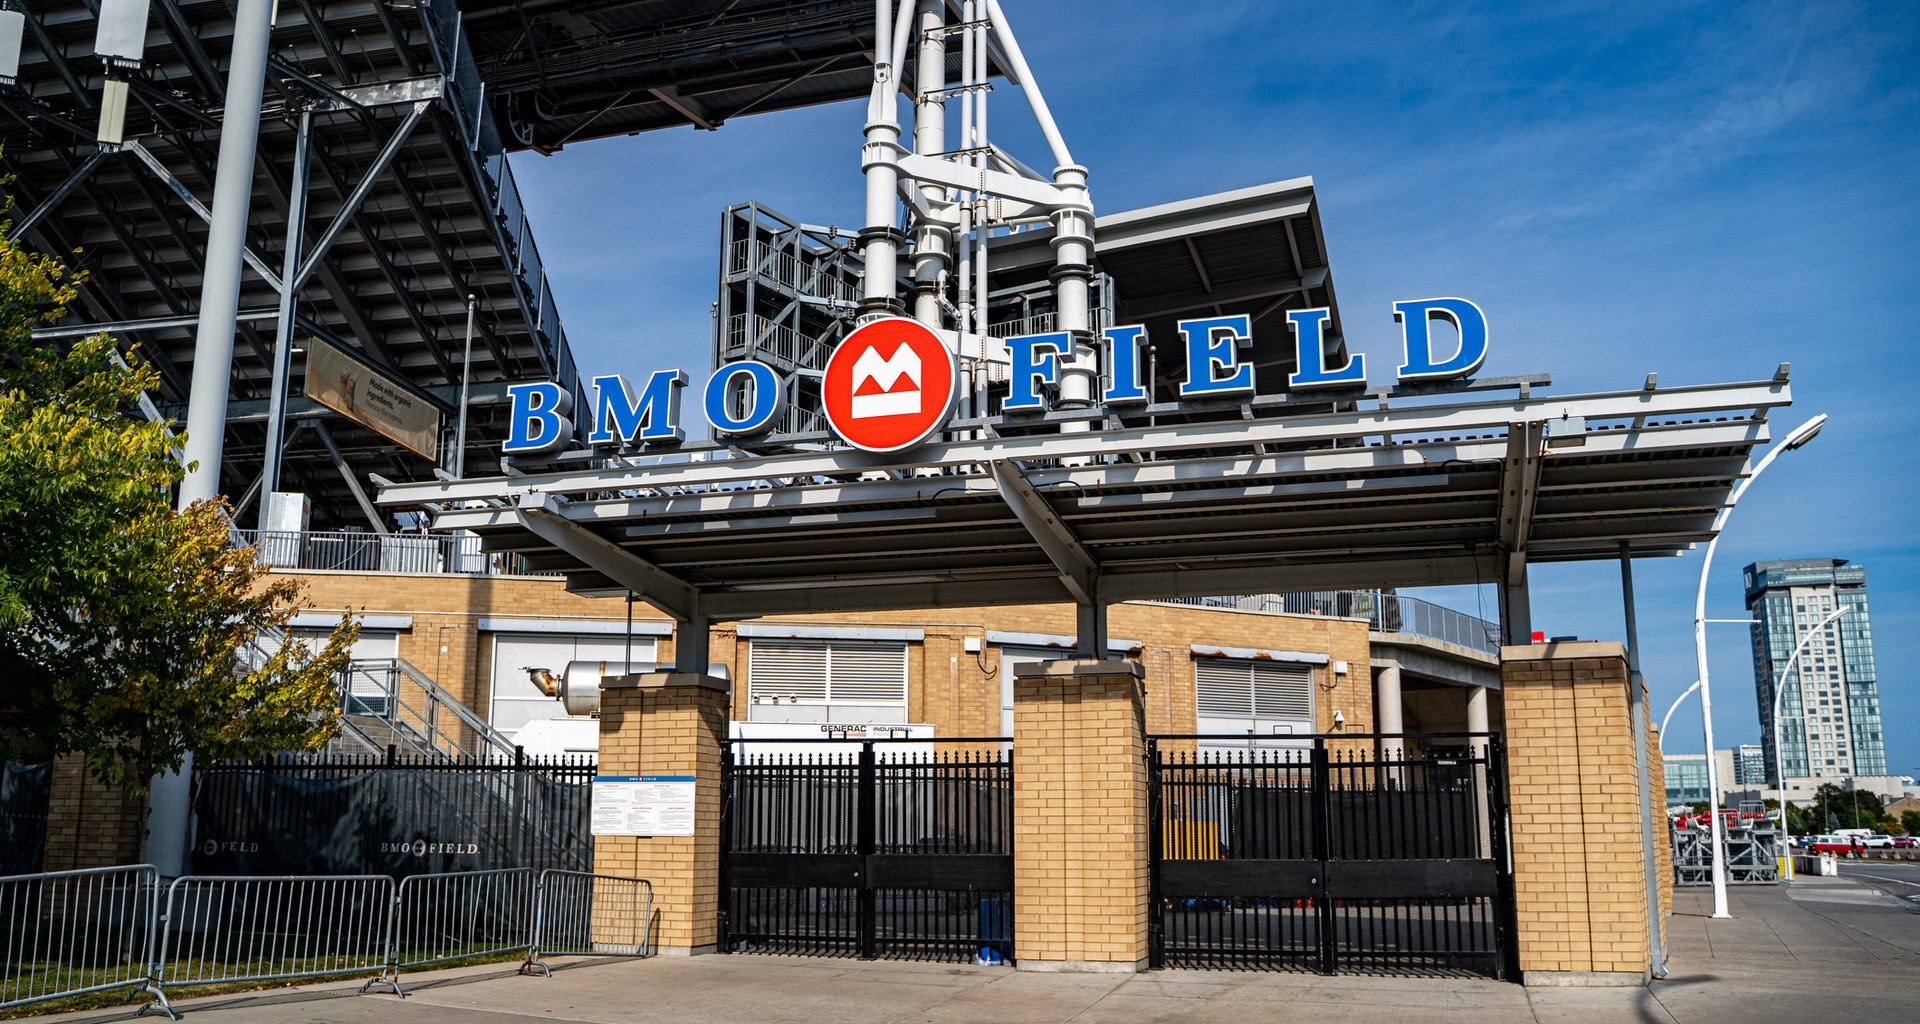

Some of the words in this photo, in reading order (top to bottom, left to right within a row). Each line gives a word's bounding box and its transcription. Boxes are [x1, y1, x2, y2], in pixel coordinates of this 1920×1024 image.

[502, 360, 787, 453] BMO
[1001, 296, 1490, 411] FIELD
[368, 378, 384, 393] Made
[384, 388, 395, 399] with
[394, 393, 412, 409] organic
[380, 842, 410, 853] BMO
